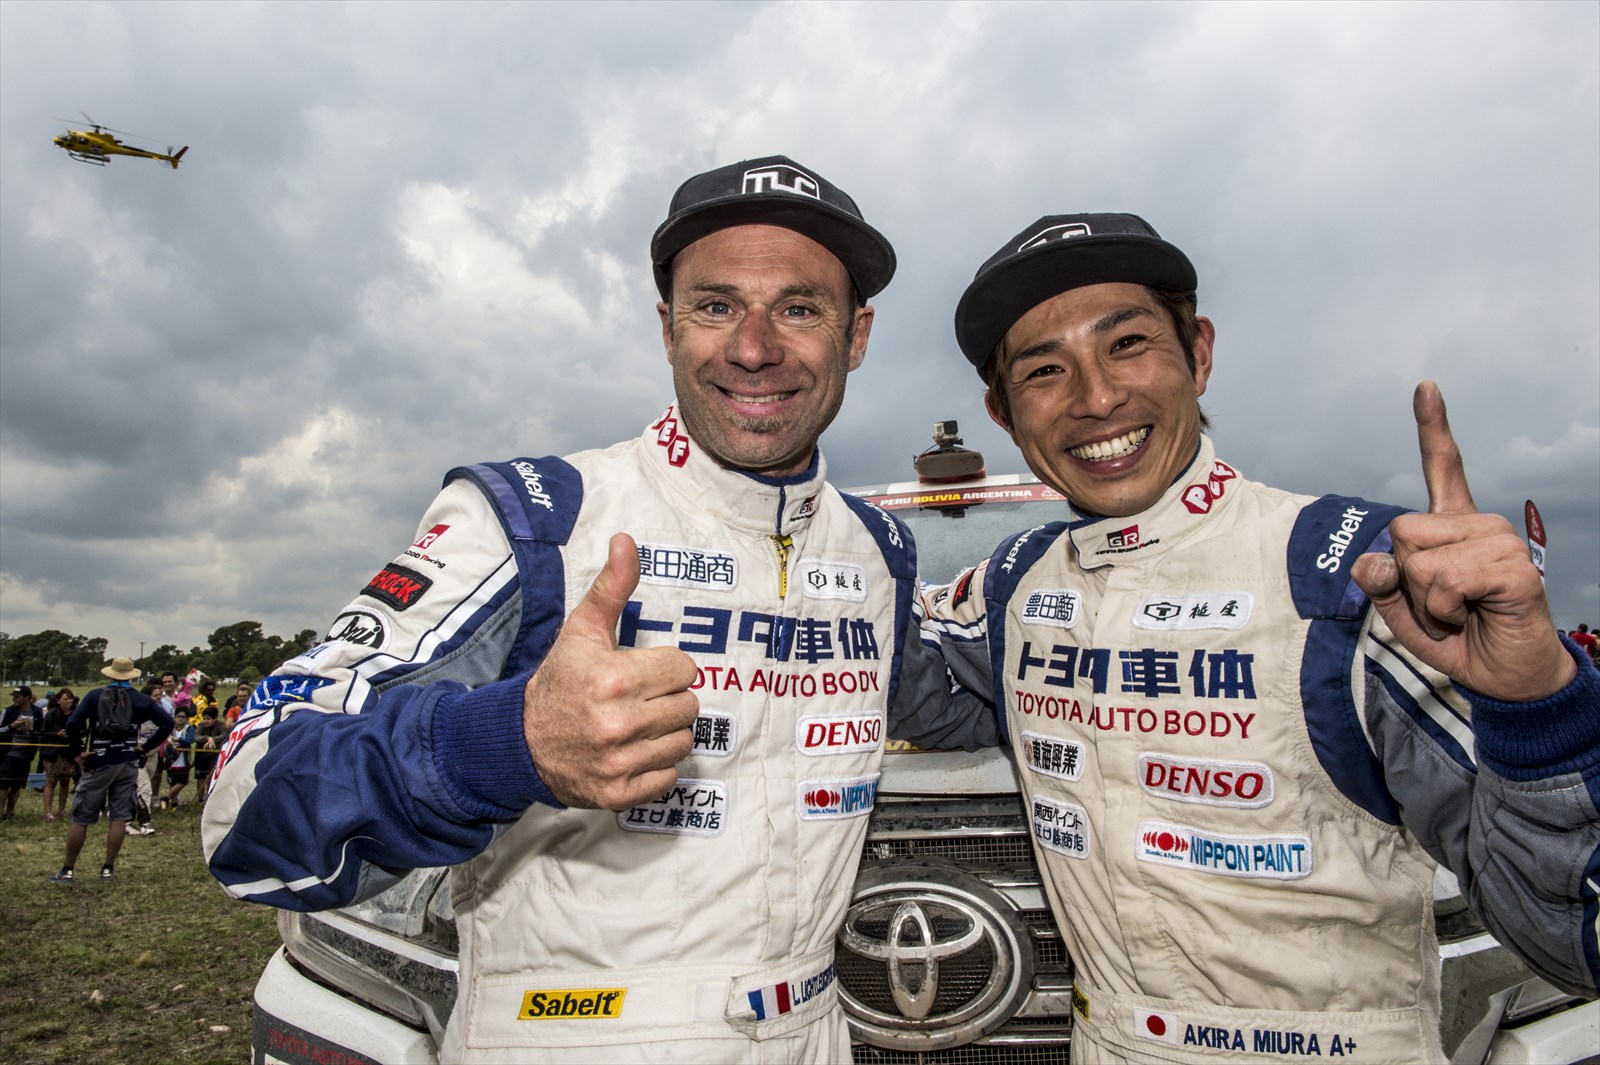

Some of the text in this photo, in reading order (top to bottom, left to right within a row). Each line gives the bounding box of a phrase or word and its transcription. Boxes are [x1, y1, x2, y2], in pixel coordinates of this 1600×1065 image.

[745, 171, 816, 195] TLC
[510, 461, 554, 509] Sabelt
[880, 490, 1033, 507] PERU BOLIVIA ARGENTINA
[1109, 532, 1138, 548] GR
[1316, 507, 1369, 574] Sabelt
[618, 600, 880, 664] トヨタ車体
[690, 666, 880, 698] OTA AUTO BODY
[1017, 641, 1257, 700] トヨタ車体
[1015, 690, 1257, 739] TOYOTA AUTO BODY
[689, 716, 731, 751] 興業
[804, 719, 881, 748] DENSO
[1145, 761, 1264, 799] DENSO
[652, 787, 724, 808] ペイント
[841, 782, 872, 813] NIPPON
[1190, 835, 1305, 873] NIPPON PAINT
[528, 992, 615, 1017] Sabelt
[269, 1028, 346, 1065] TOYOTA AUTO
[1184, 1023, 1357, 1057] AKIRA MIURA A+
